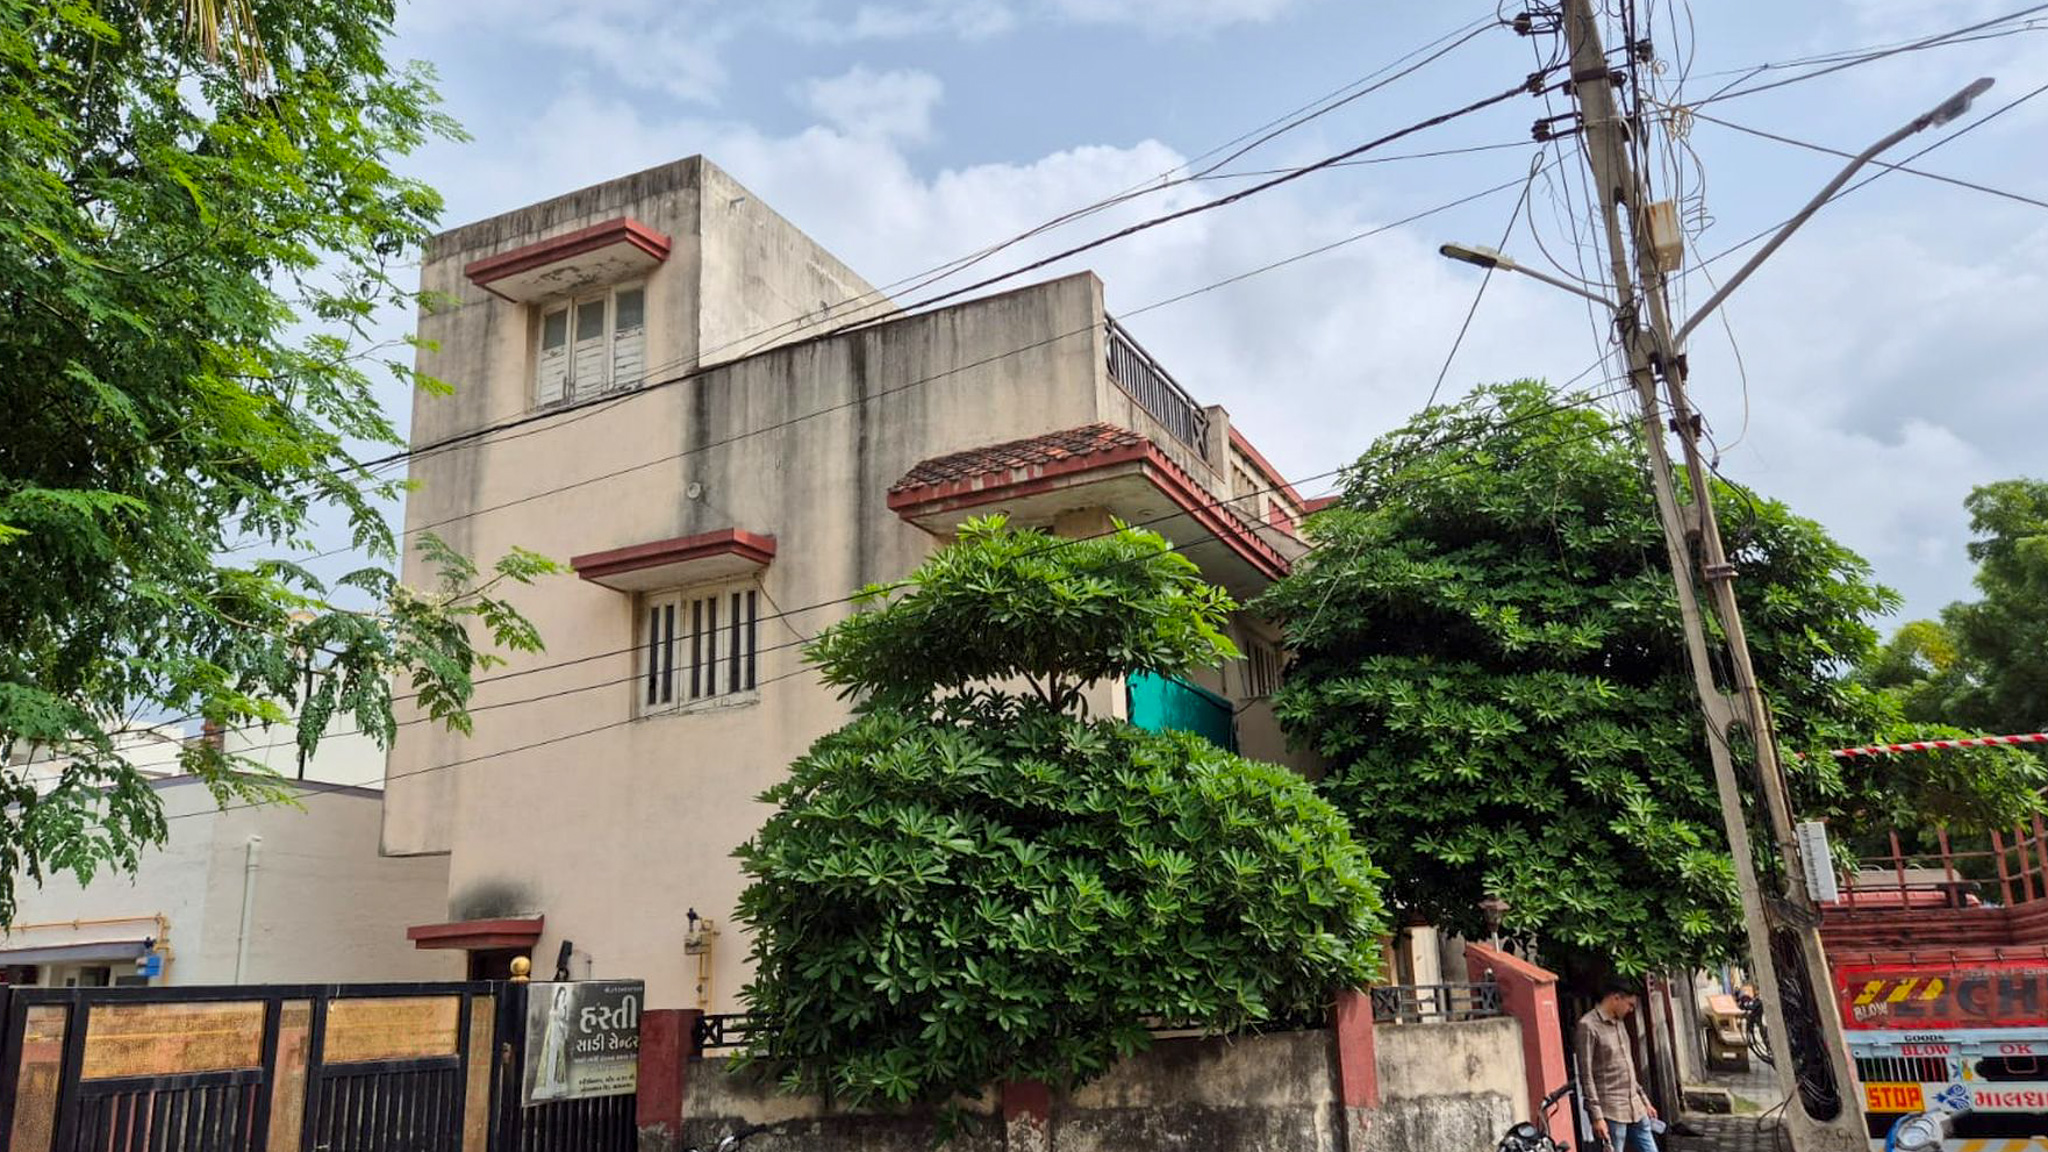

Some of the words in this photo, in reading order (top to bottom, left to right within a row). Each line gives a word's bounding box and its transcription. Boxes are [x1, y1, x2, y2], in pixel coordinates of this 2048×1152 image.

[1853, 1000, 1888, 1022] BLOW
[576, 1033, 604, 1052] સાડી
[1904, 1034, 1945, 1042] GOODS
[1901, 1043, 1950, 1056] BLOW
[2001, 1043, 2033, 1054] OK
[1868, 1086, 1921, 1108] STOP
[1974, 1091, 2048, 1107] માલધ
